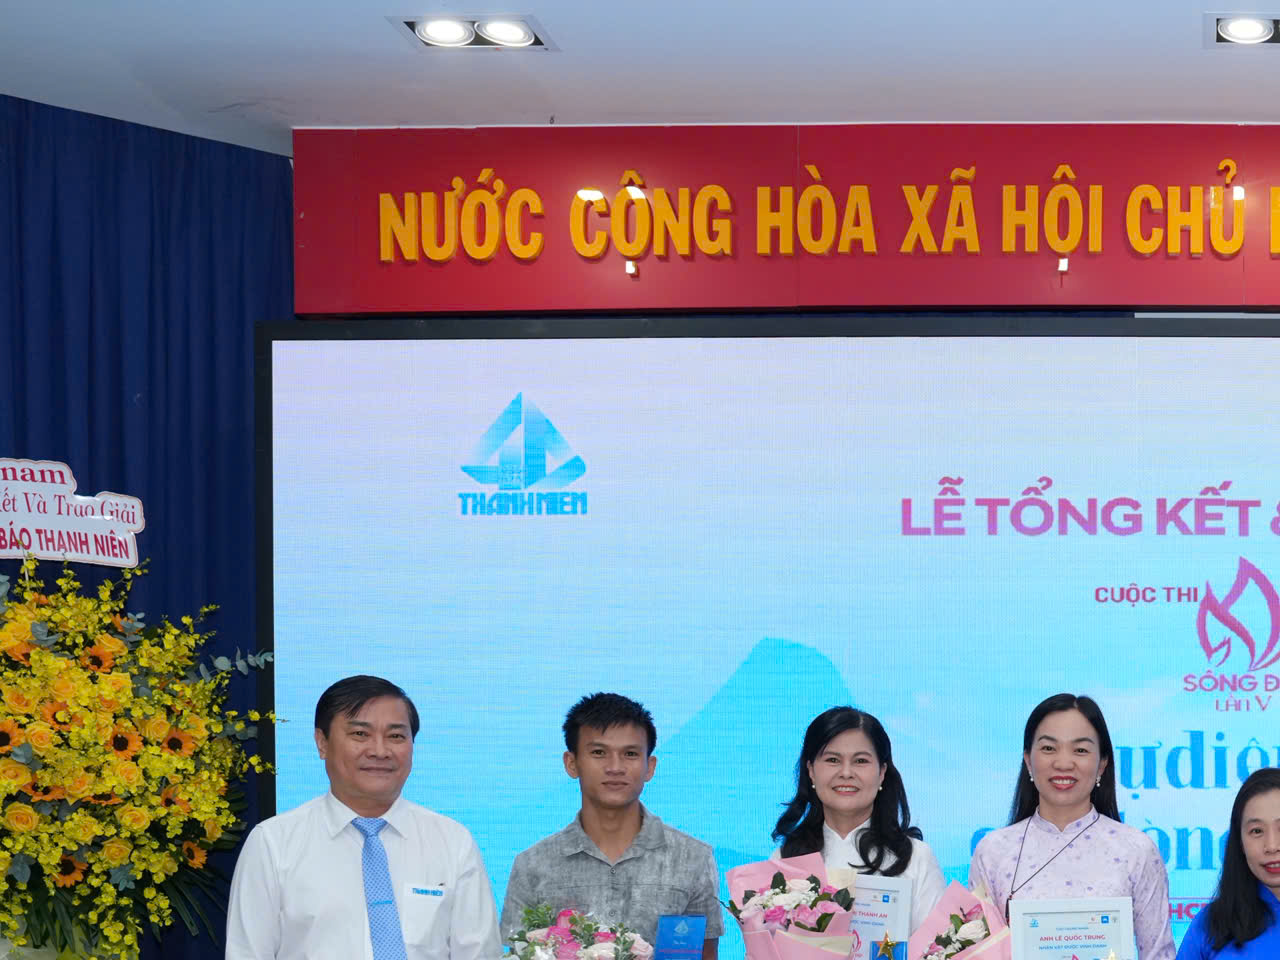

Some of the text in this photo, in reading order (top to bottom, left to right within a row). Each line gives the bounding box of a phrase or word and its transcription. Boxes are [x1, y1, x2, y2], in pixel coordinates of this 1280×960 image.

[380, 168, 546, 263] NƯỚC
[570, 170, 733, 275] CỘNG
[756, 164, 878, 256] HÒA
[900, 166, 981, 253] XÃ
[1002, 164, 1103, 272] HỘI
[1126, 158, 1246, 256] CHỦ
[0, 487, 137, 525] ết Và Trao Giải
[901, 476, 966, 536] LỄ
[974, 476, 1143, 536] TỔNG
[1156, 480, 1262, 537] KẾT
[0, 520, 130, 559] BÁO THANH NIÊN
[1095, 582, 1199, 607] CUỘC THI
